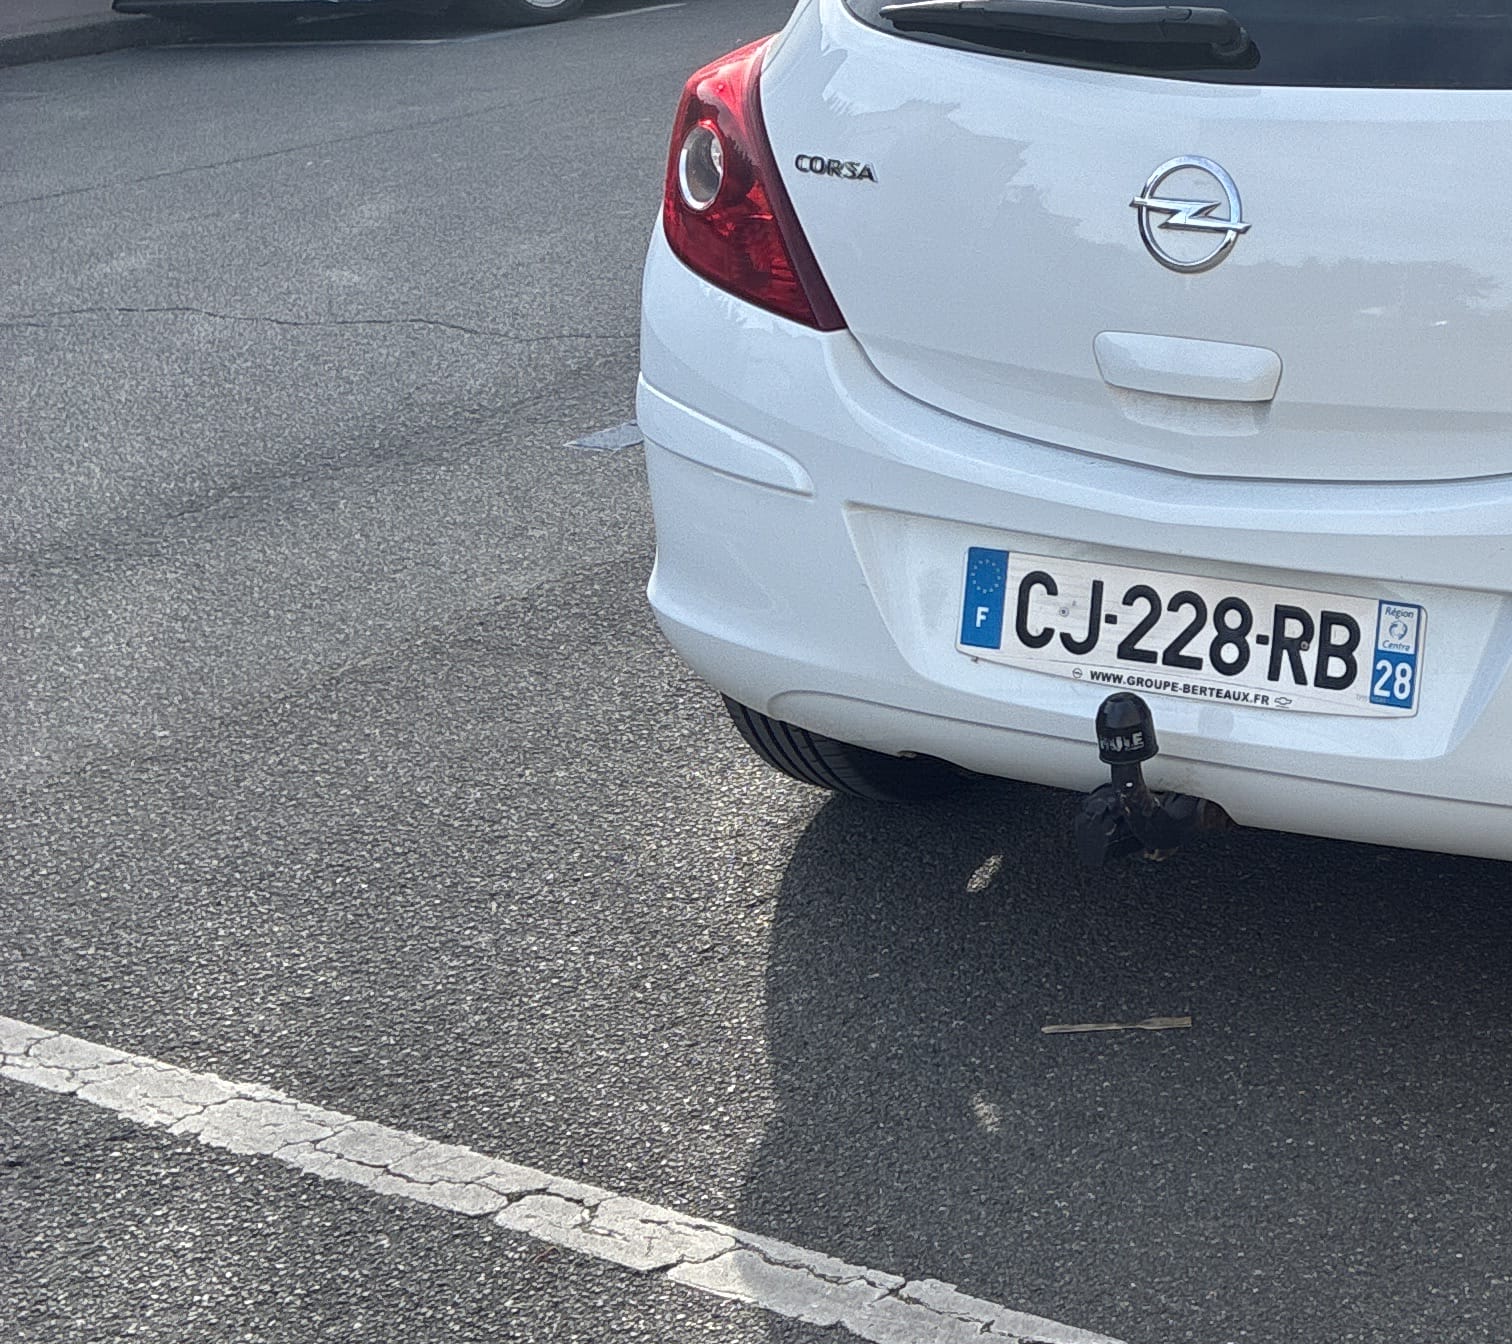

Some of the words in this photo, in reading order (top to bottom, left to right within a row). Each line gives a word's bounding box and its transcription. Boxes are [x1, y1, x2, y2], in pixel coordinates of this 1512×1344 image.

[794, 154, 879, 183] CORSA
[975, 606, 989, 629] F
[1384, 606, 1415, 620] Région
[1014, 570, 1362, 691] CJ-228-RB
[1382, 639, 1411, 652] Centre
[1089, 669, 1270, 706] WWW.GROUPE-BERTEAUX.FR
[1373, 659, 1413, 700] 28
